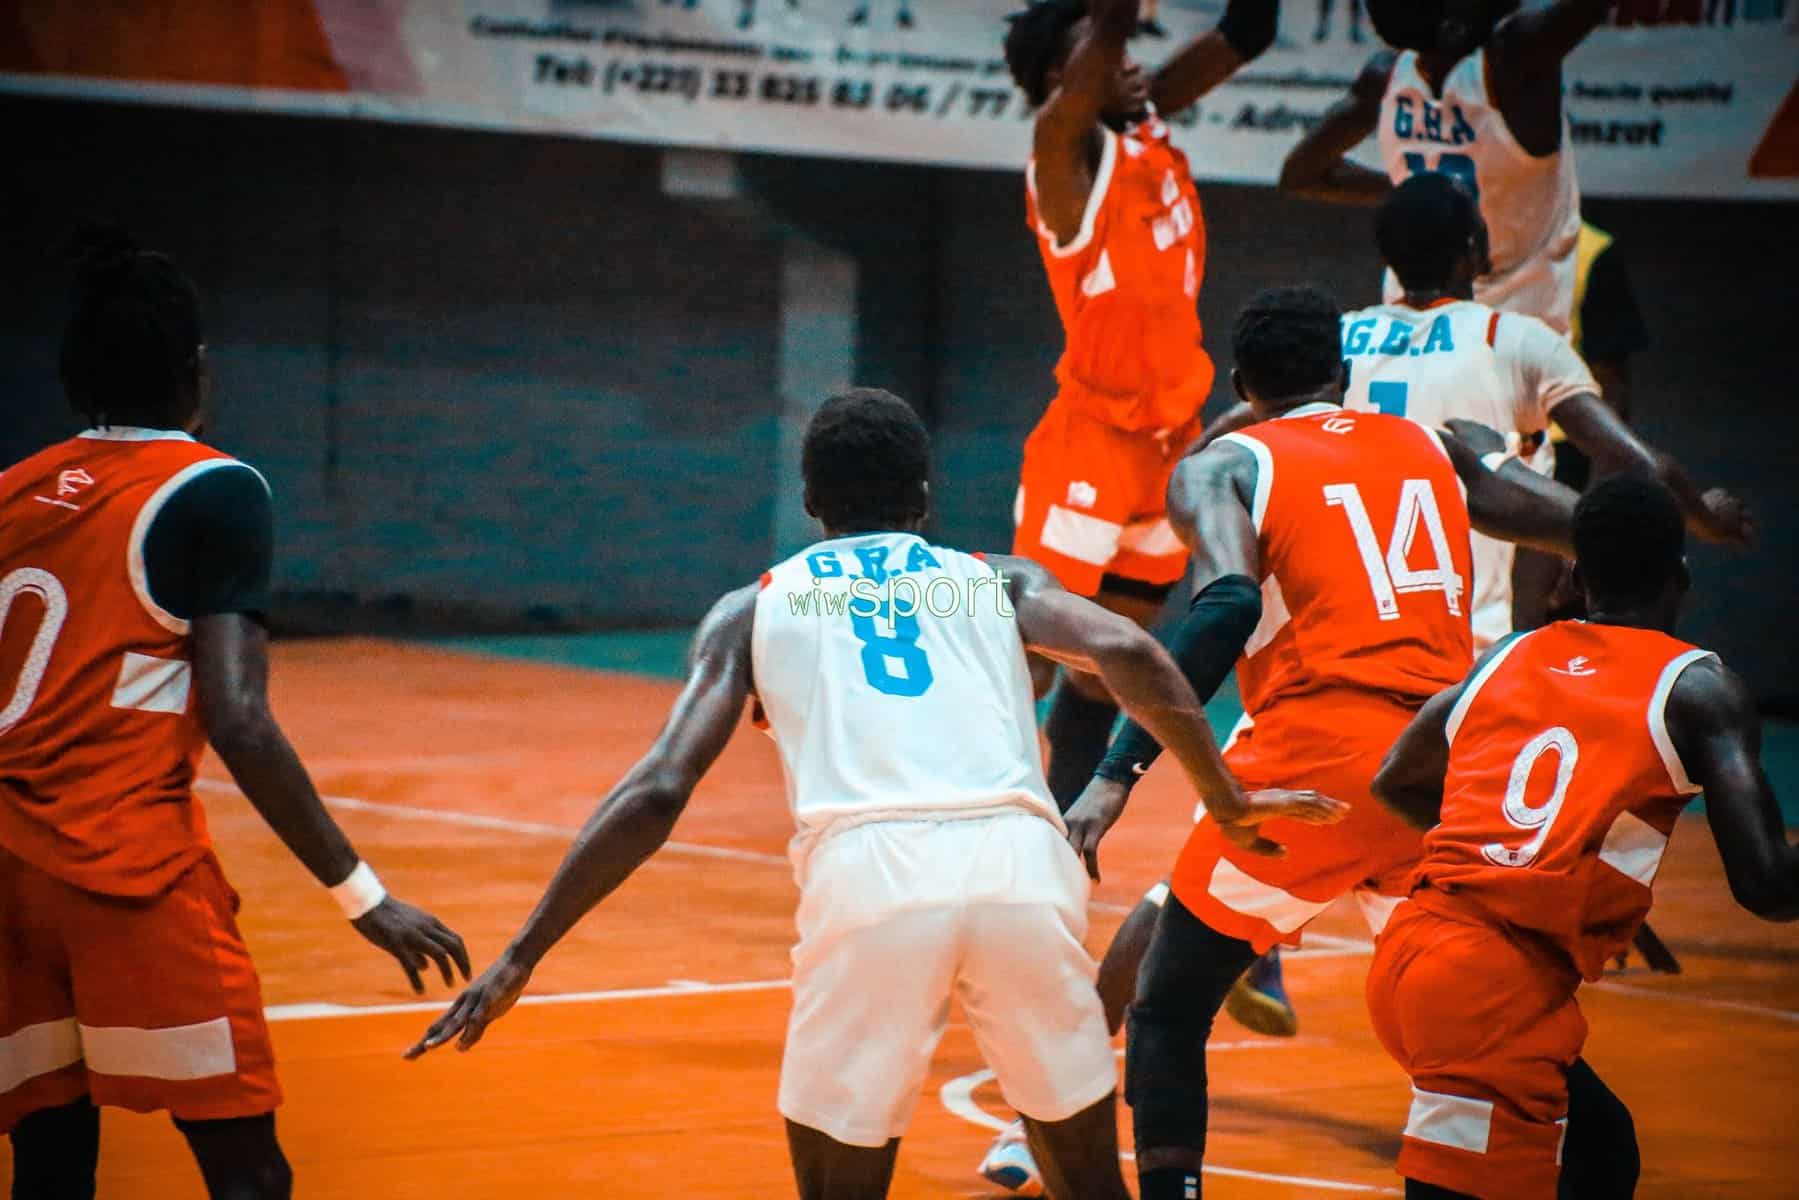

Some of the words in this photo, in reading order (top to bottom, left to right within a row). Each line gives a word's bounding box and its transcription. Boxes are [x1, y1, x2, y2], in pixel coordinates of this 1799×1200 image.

[1344, 313, 1455, 357] G.B.A
[1323, 479, 1464, 621] 14
[848, 596, 935, 698] 8
[1480, 726, 1580, 869] 9
